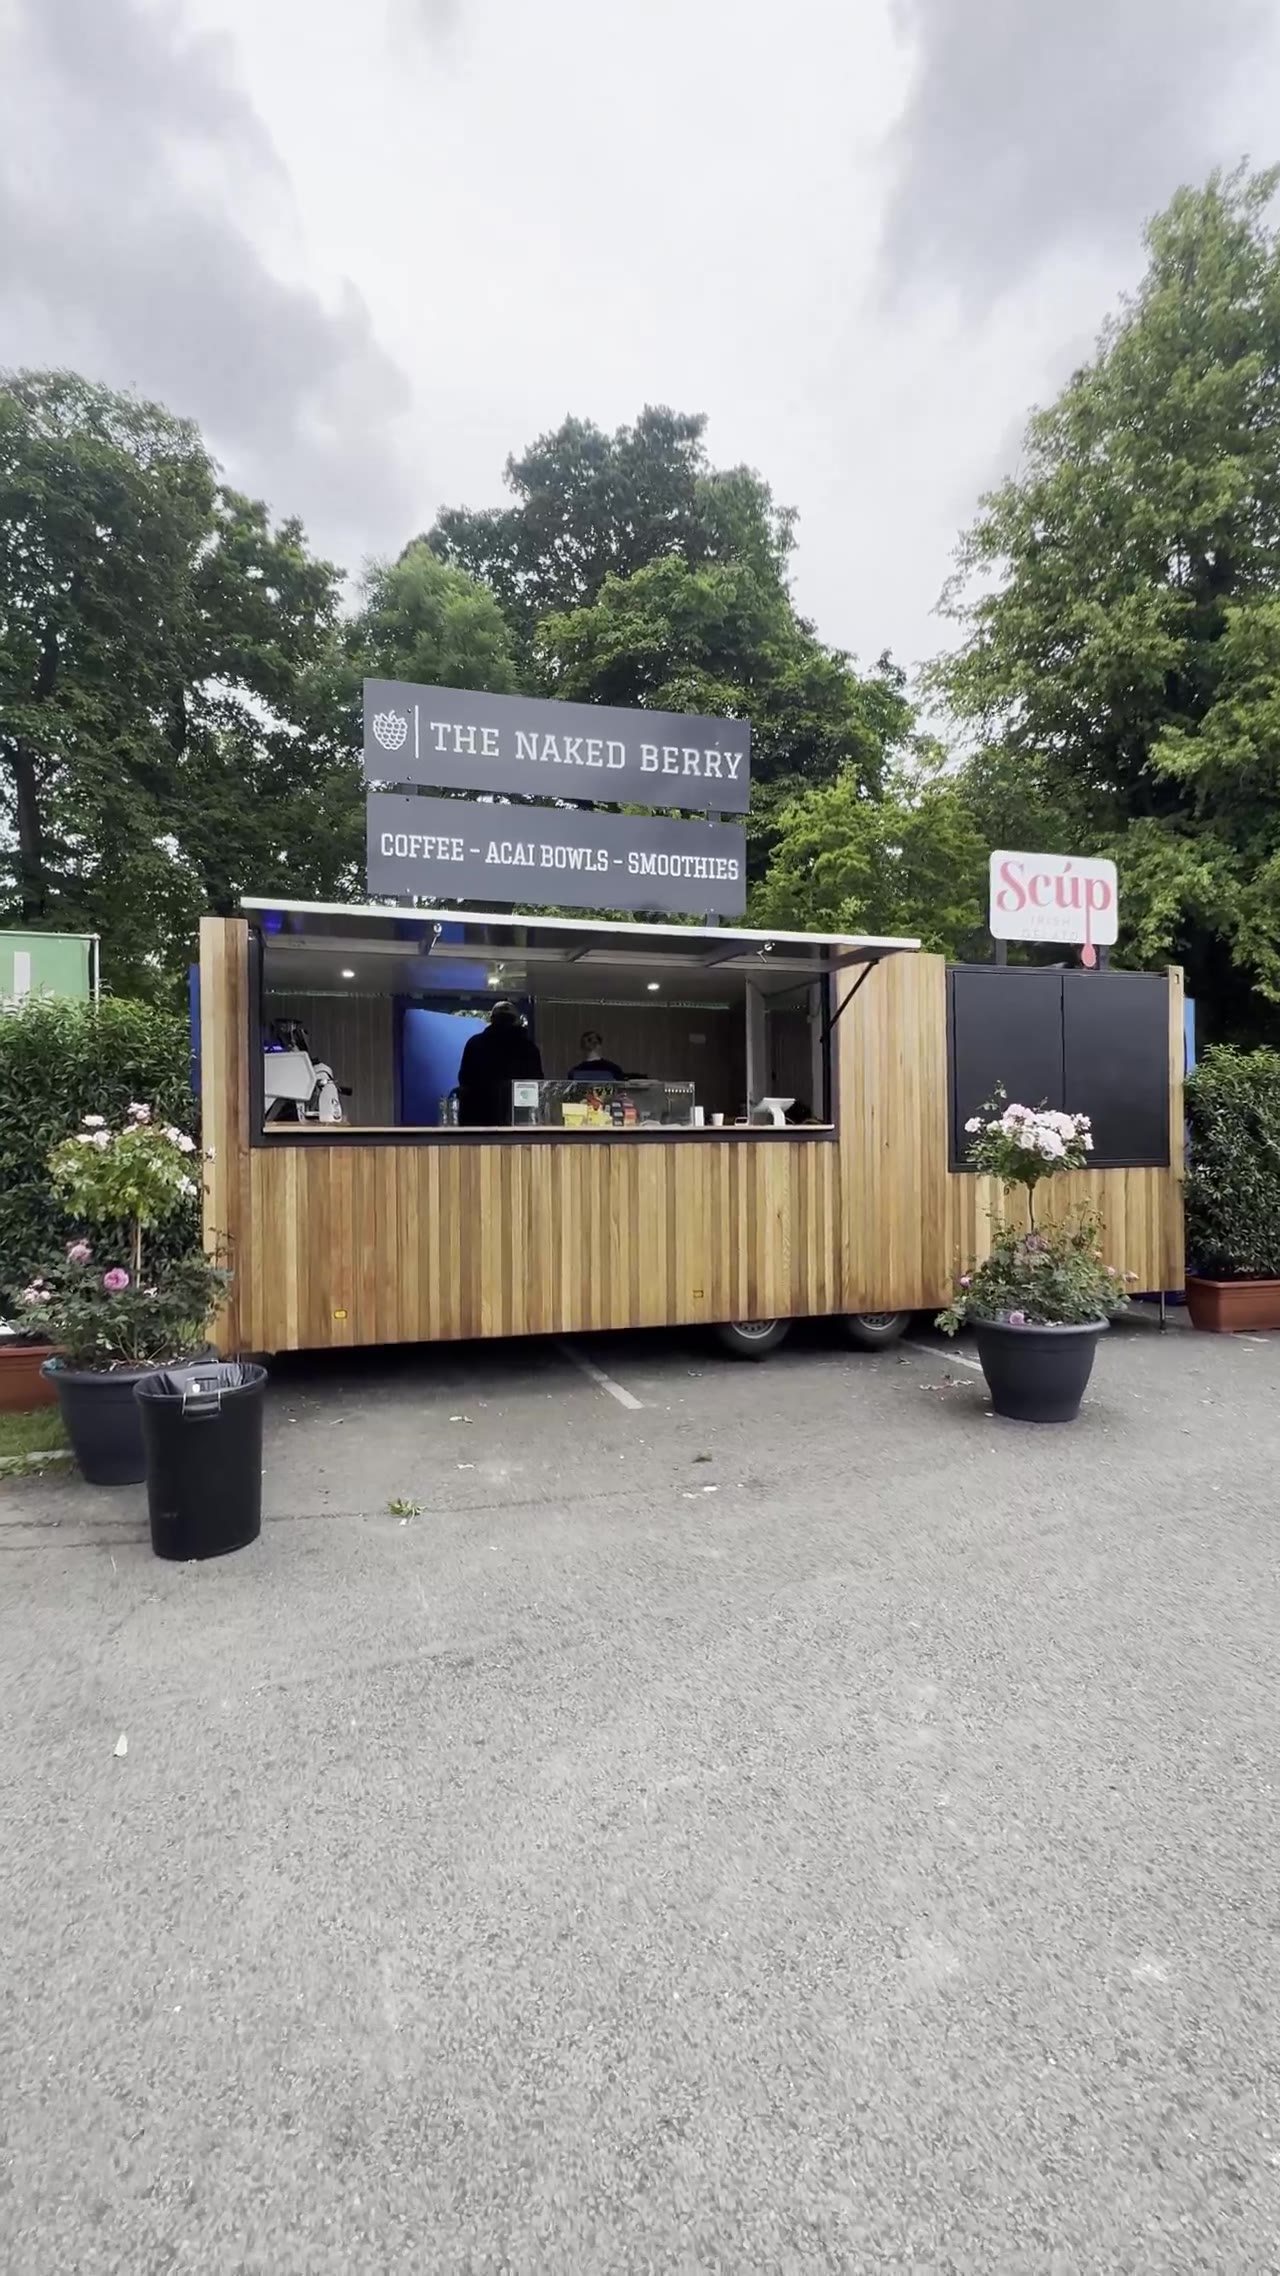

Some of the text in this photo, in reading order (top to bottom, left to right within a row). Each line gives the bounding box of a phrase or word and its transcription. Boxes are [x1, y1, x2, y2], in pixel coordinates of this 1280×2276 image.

[430, 721, 743, 780] THE NAKED BERRY
[381, 832, 464, 861] COFFEE
[485, 841, 535, 866] ACAI
[540, 844, 608, 871] BOWLS
[628, 851, 739, 880] SMOOTHIES
[996, 860, 1112, 944] Scúp
